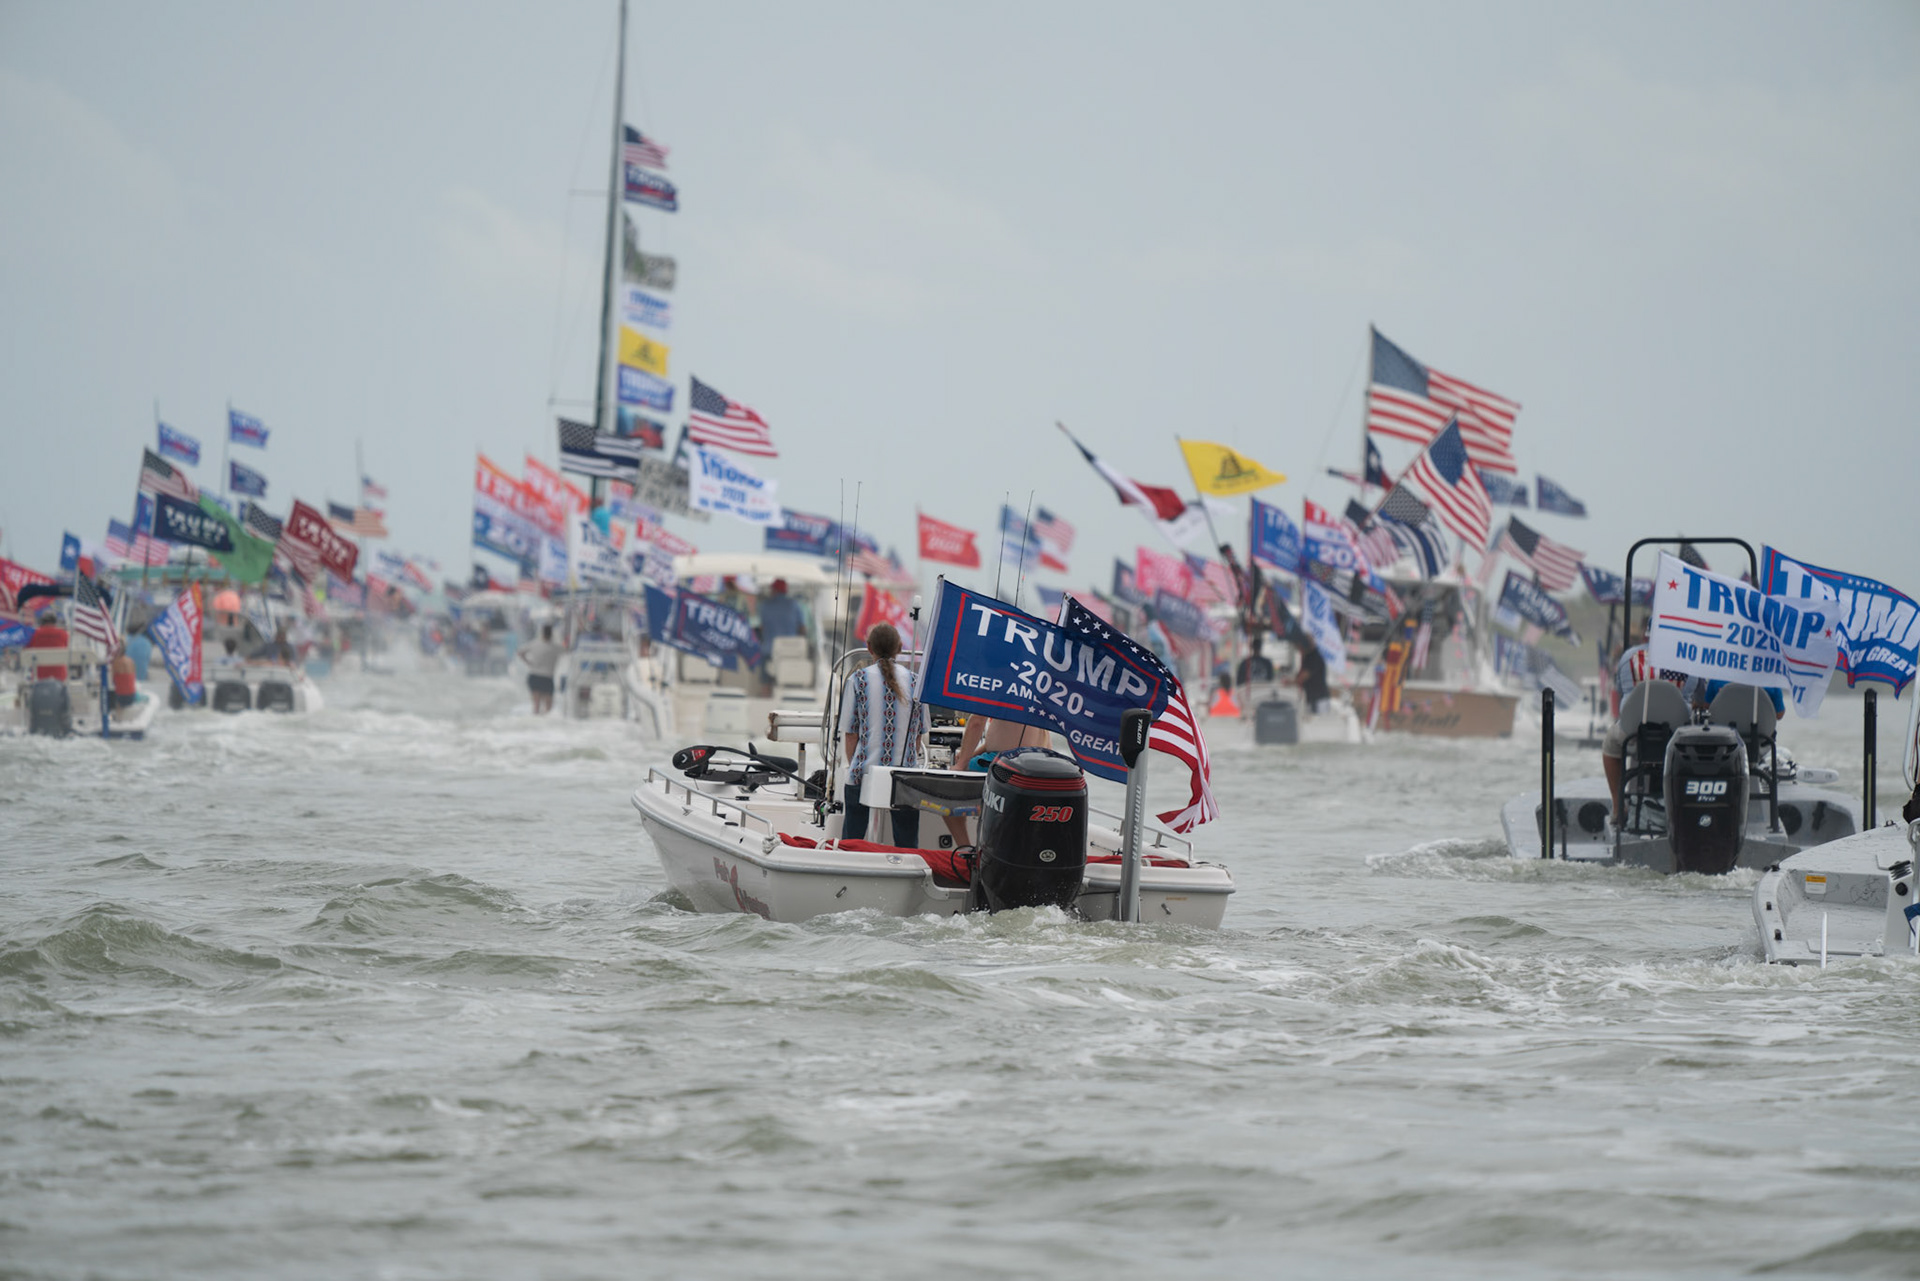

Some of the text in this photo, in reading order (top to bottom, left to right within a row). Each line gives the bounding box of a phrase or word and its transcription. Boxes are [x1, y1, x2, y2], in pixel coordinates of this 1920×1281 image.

[684, 598, 751, 643] TRUM
[1682, 566, 1826, 650] TRUMP
[970, 603, 1148, 697] TRUMP
[1726, 622, 1781, 654] 2020
[1676, 641, 1697, 662] NO
[1701, 647, 1749, 672] MORE
[1866, 646, 1916, 676] GREAT
[1010, 660, 1095, 719] -2020-
[955, 671, 1003, 692] KEEP
[1069, 729, 1121, 756] GREAT
[983, 786, 1006, 814] UKI
[1685, 781, 1727, 795] 300
[1029, 805, 1074, 823] 250
